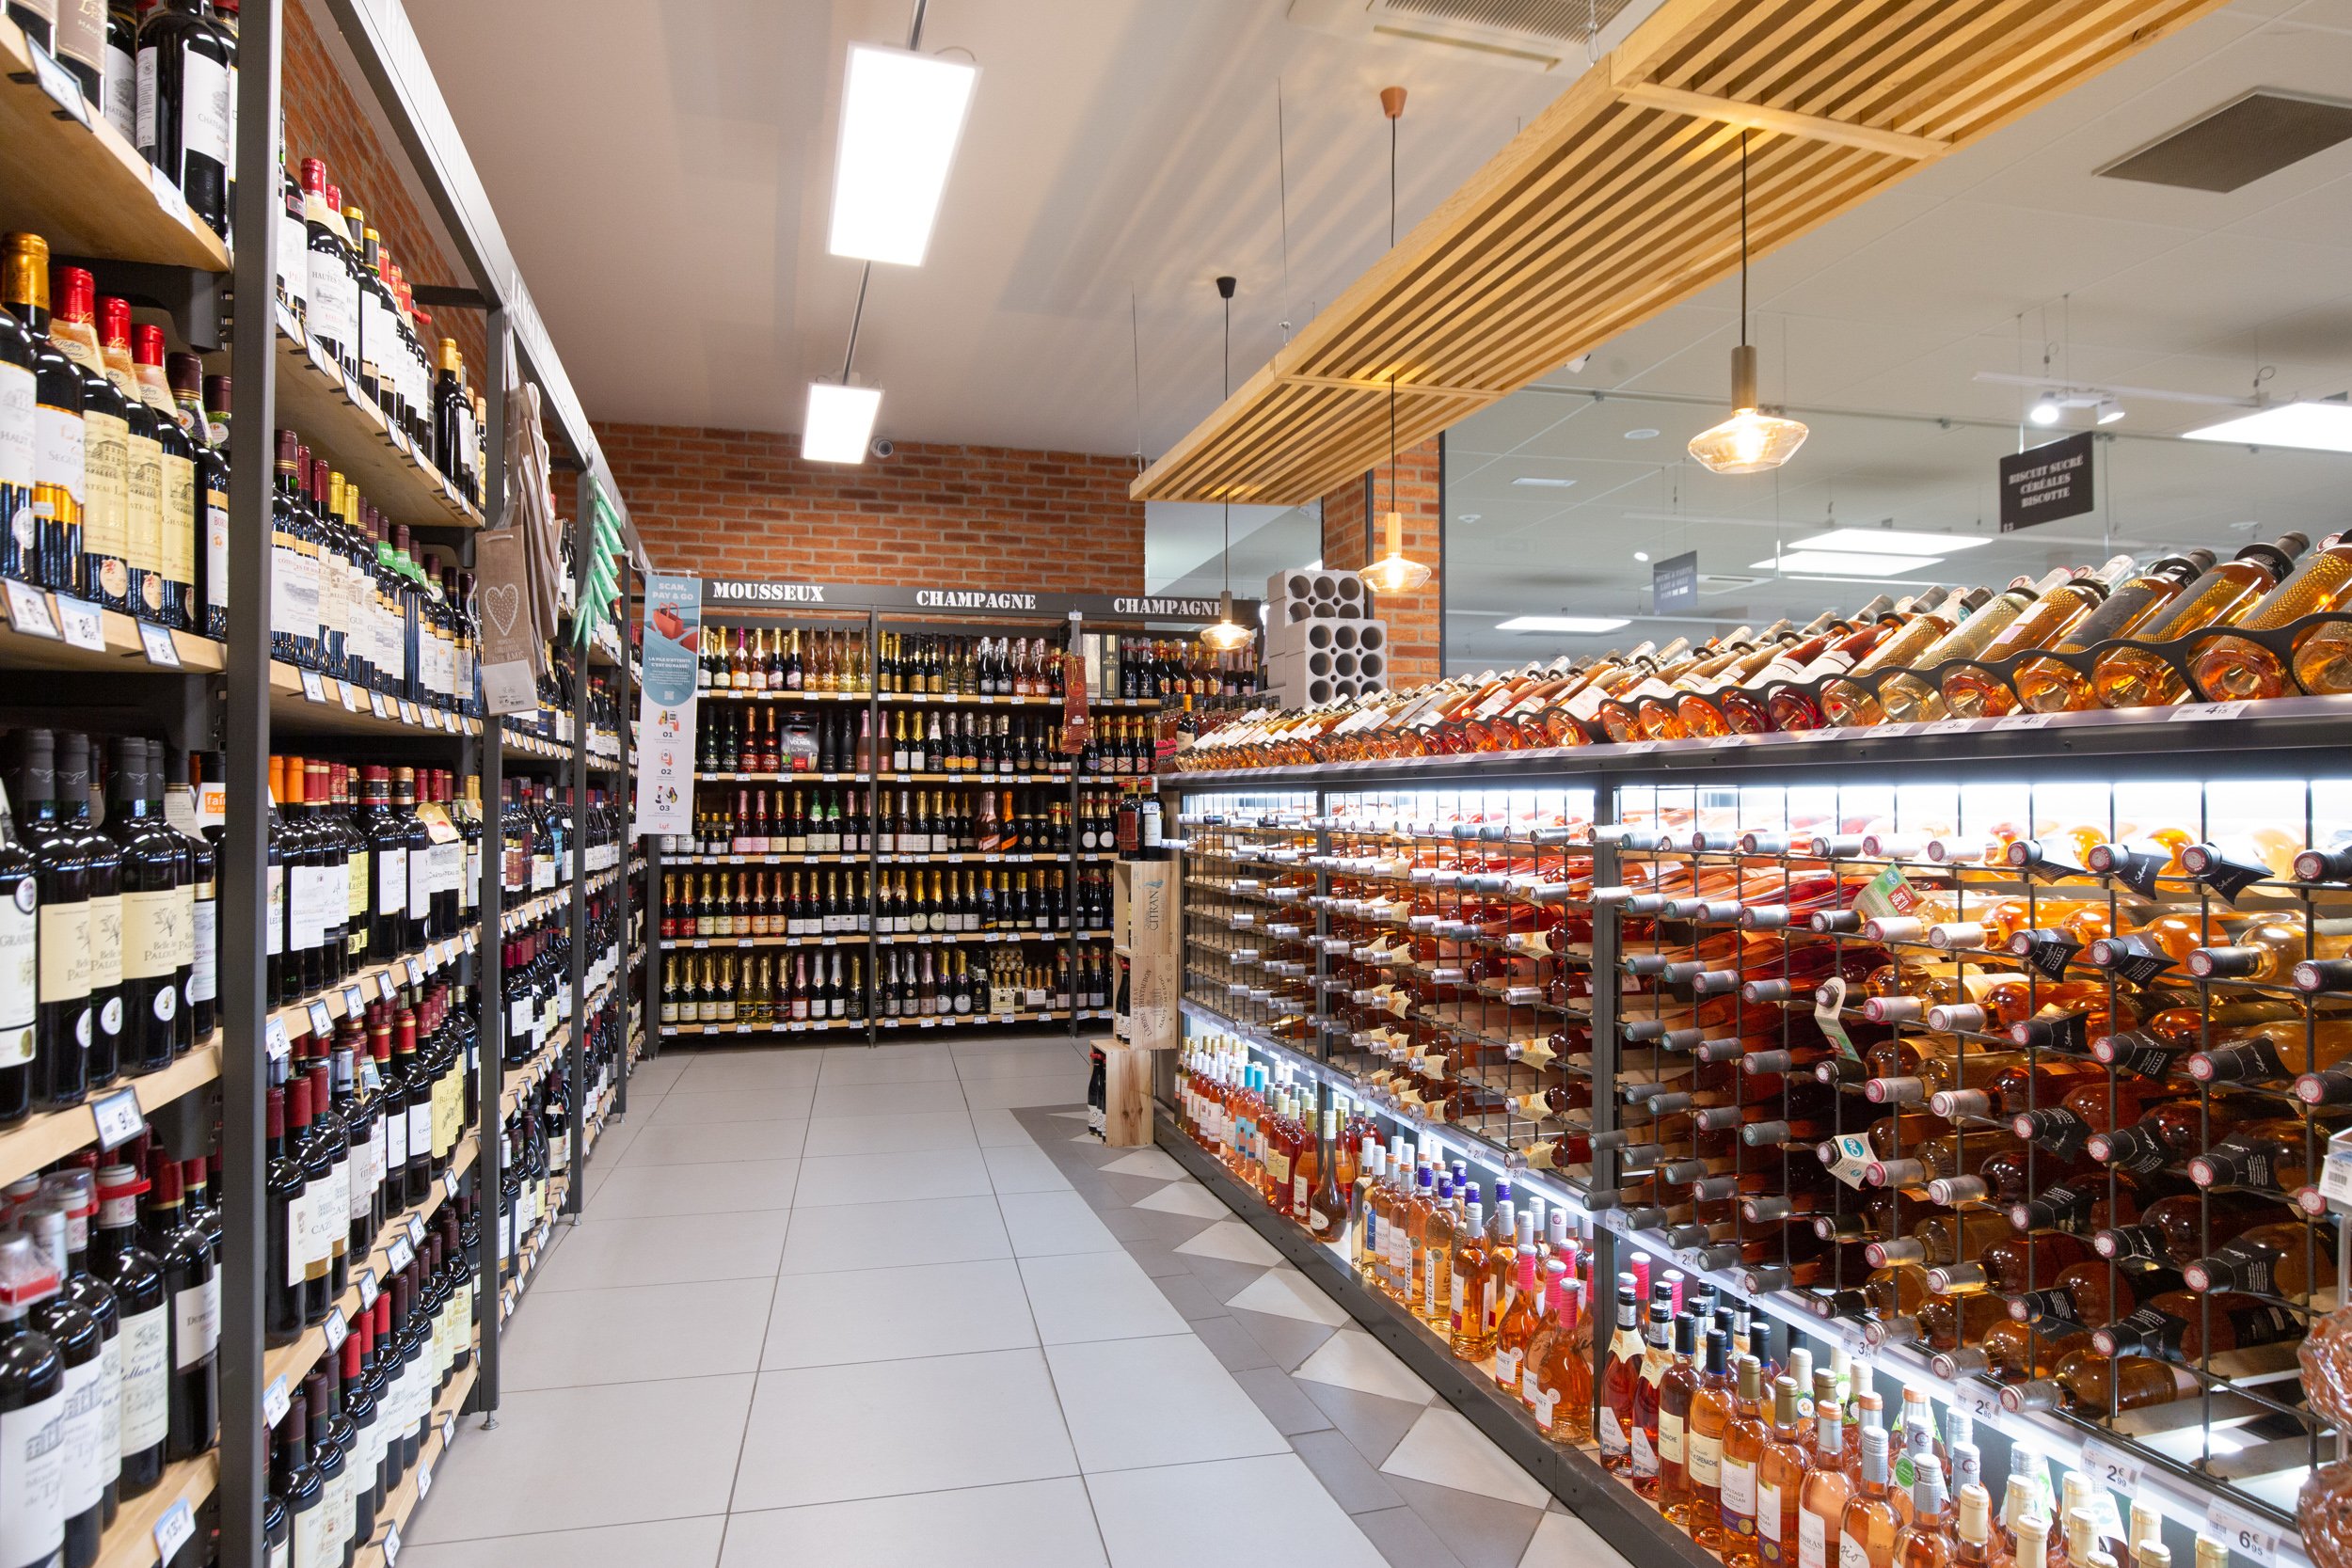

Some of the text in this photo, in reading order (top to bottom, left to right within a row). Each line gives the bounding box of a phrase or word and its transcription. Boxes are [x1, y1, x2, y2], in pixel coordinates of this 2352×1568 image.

[2008, 453, 2084, 485] BISCUIT SUCRÉ
[2020, 472, 2071, 495] CÉRÉALES
[2021, 486, 2071, 509] BISCOTTE
[652, 591, 670, 600] PAY
[659, 582, 687, 592] SCAN,
[713, 582, 824, 602] MOUSSEUX
[916, 590, 1036, 610] CHAMPAGNE
[1149, 891, 1158, 931] CITRAN
[1846, 1138, 1861, 1157] CAB
